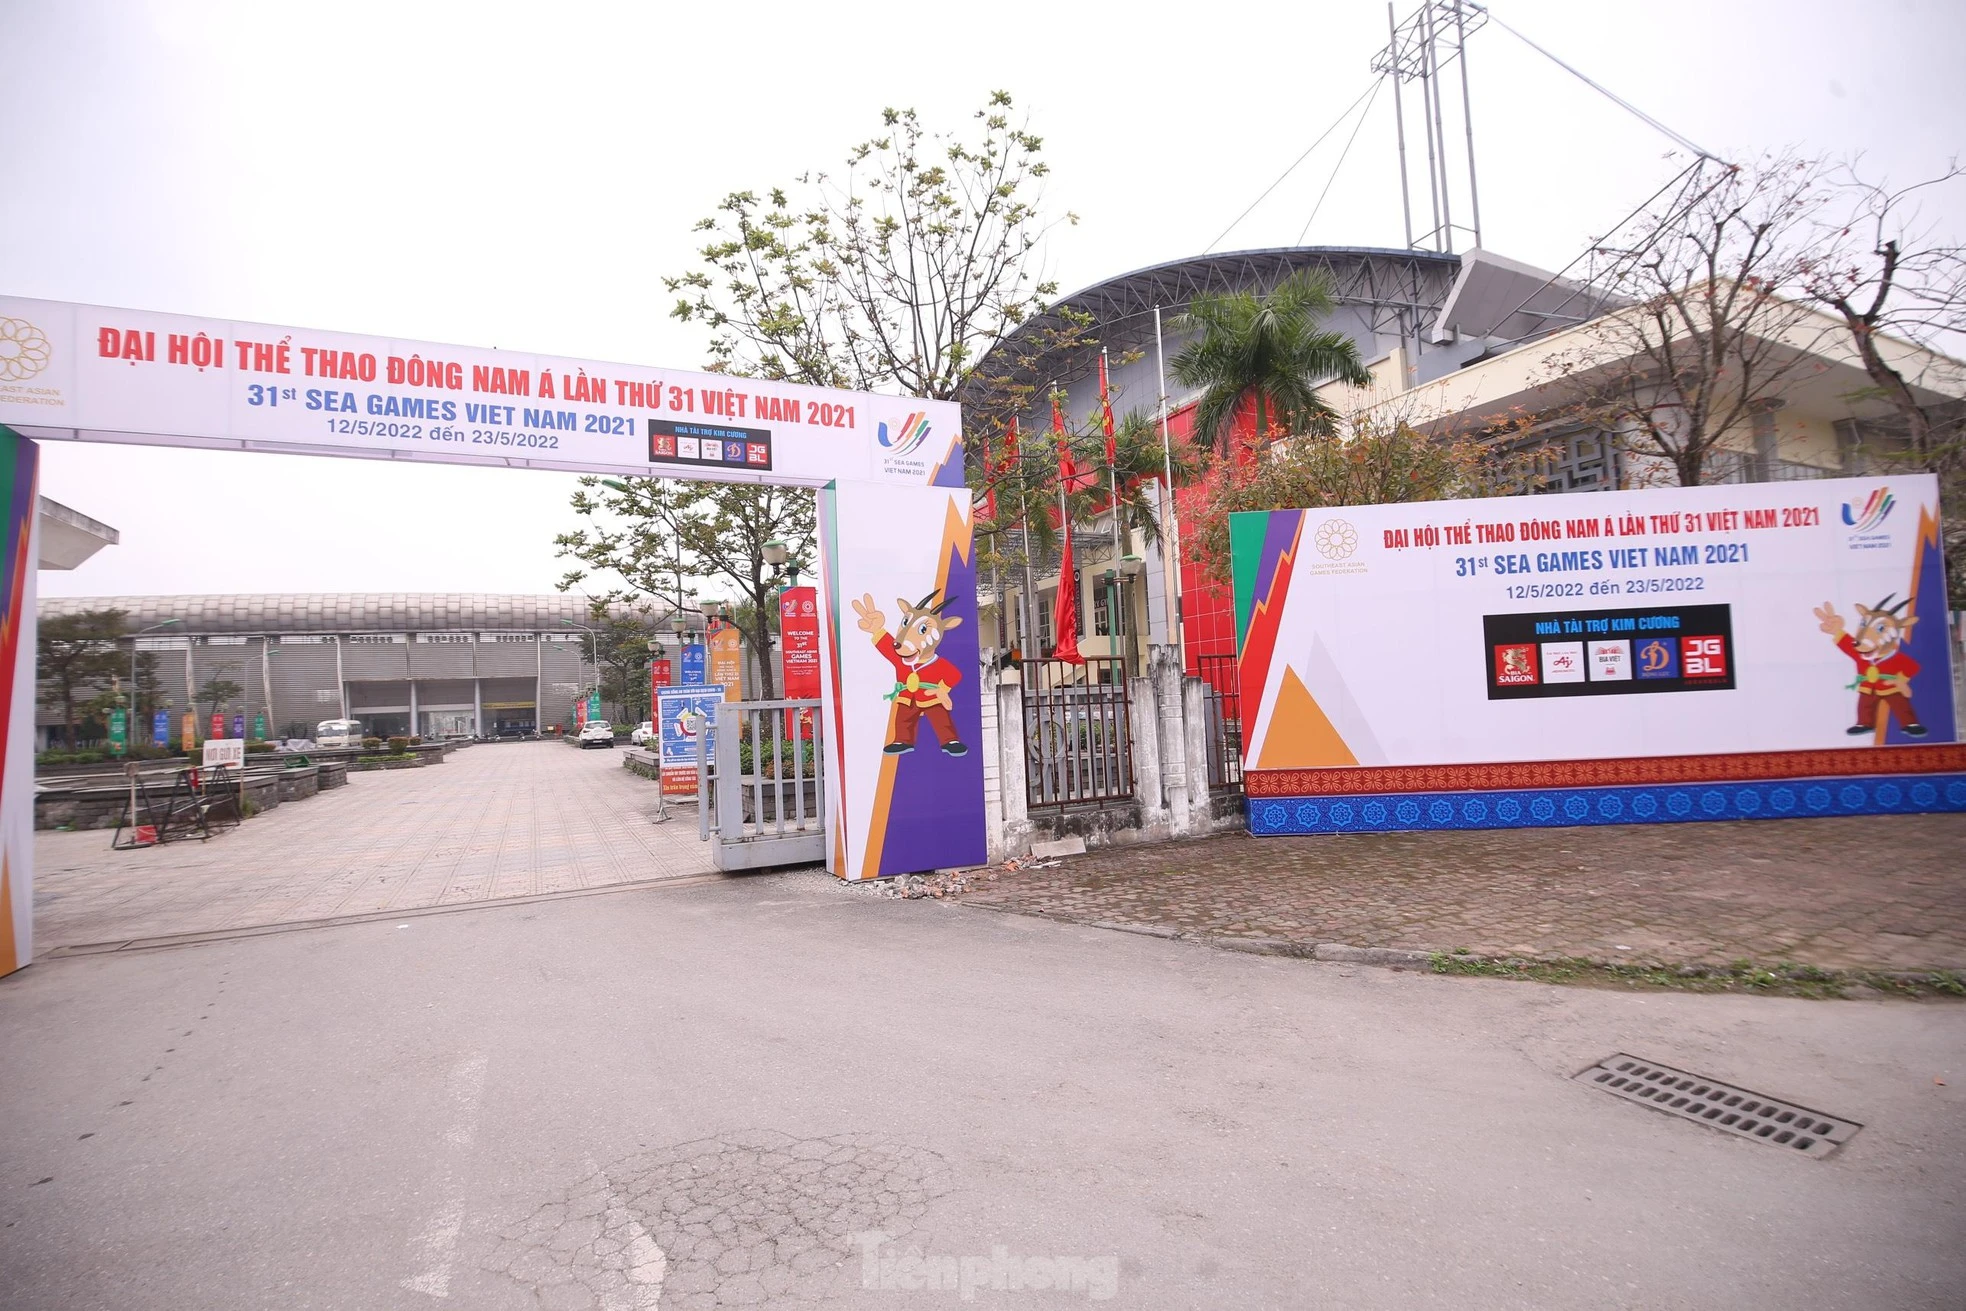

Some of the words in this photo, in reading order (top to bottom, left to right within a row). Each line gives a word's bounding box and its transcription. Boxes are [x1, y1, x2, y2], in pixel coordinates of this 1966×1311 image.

[97, 327, 155, 366] ĐẠI
[167, 332, 223, 372] HỘI
[235, 335, 292, 375] THỂ
[301, 347, 376, 383] THAO
[387, 354, 463, 391] ĐÔNG
[473, 365, 529, 397] NAM
[538, 369, 555, 399] Á
[564, 367, 606, 404] LẦN
[614, 380, 663, 409] THỨ
[669, 386, 694, 412] 31
[701, 388, 748, 421] VIỆT
[755, 396, 800, 423] NAM
[807, 401, 855, 429] 2021
[247, 384, 297, 407] 31st
[306, 389, 358, 413] SEA
[367, 394, 457, 421] GAMES
[465, 402, 516, 426] VIET
[523, 408, 577, 431] NAM
[584, 414, 635, 436] 2021
[327, 418, 422, 439] 12/5/2022
[429, 426, 465, 442] đến
[472, 430, 559, 449] 23/5/2022
[1383, 529, 1409, 551] ĐẠI
[1413, 524, 1440, 550] HỘI
[1444, 518, 1472, 545] THỂ
[1475, 522, 1515, 544] THAO
[1520, 518, 1561, 541] ĐÔNG
[1566, 518, 1600, 539] NAM
[1604, 515, 1615, 537] Á
[1619, 510, 1646, 536] LẦN
[1650, 511, 1681, 534] THỨ
[1685, 513, 1702, 533] 31
[1706, 509, 1738, 534] VIỆT
[1743, 509, 1778, 529] NAM
[1782, 506, 1820, 527] 2021
[1456, 556, 1488, 577] 31st
[1494, 554, 1531, 575] SEA
[1537, 550, 1603, 573] GAMES
[1609, 548, 1648, 569] VIET
[1654, 546, 1699, 567] NAM
[1705, 543, 1749, 564] 2021
[1506, 583, 1584, 599] 12/5/2022
[1589, 579, 1620, 595] đến
[1626, 577, 1704, 594] 23/5/2022
[1535, 619, 1561, 635] NHÀ
[1564, 619, 1583, 633] TÀI
[1587, 618, 1609, 634] TRỢ
[1612, 618, 1636, 631] KIM
[1685, 639, 1721, 656] JG
[1685, 657, 1722, 673] BL
